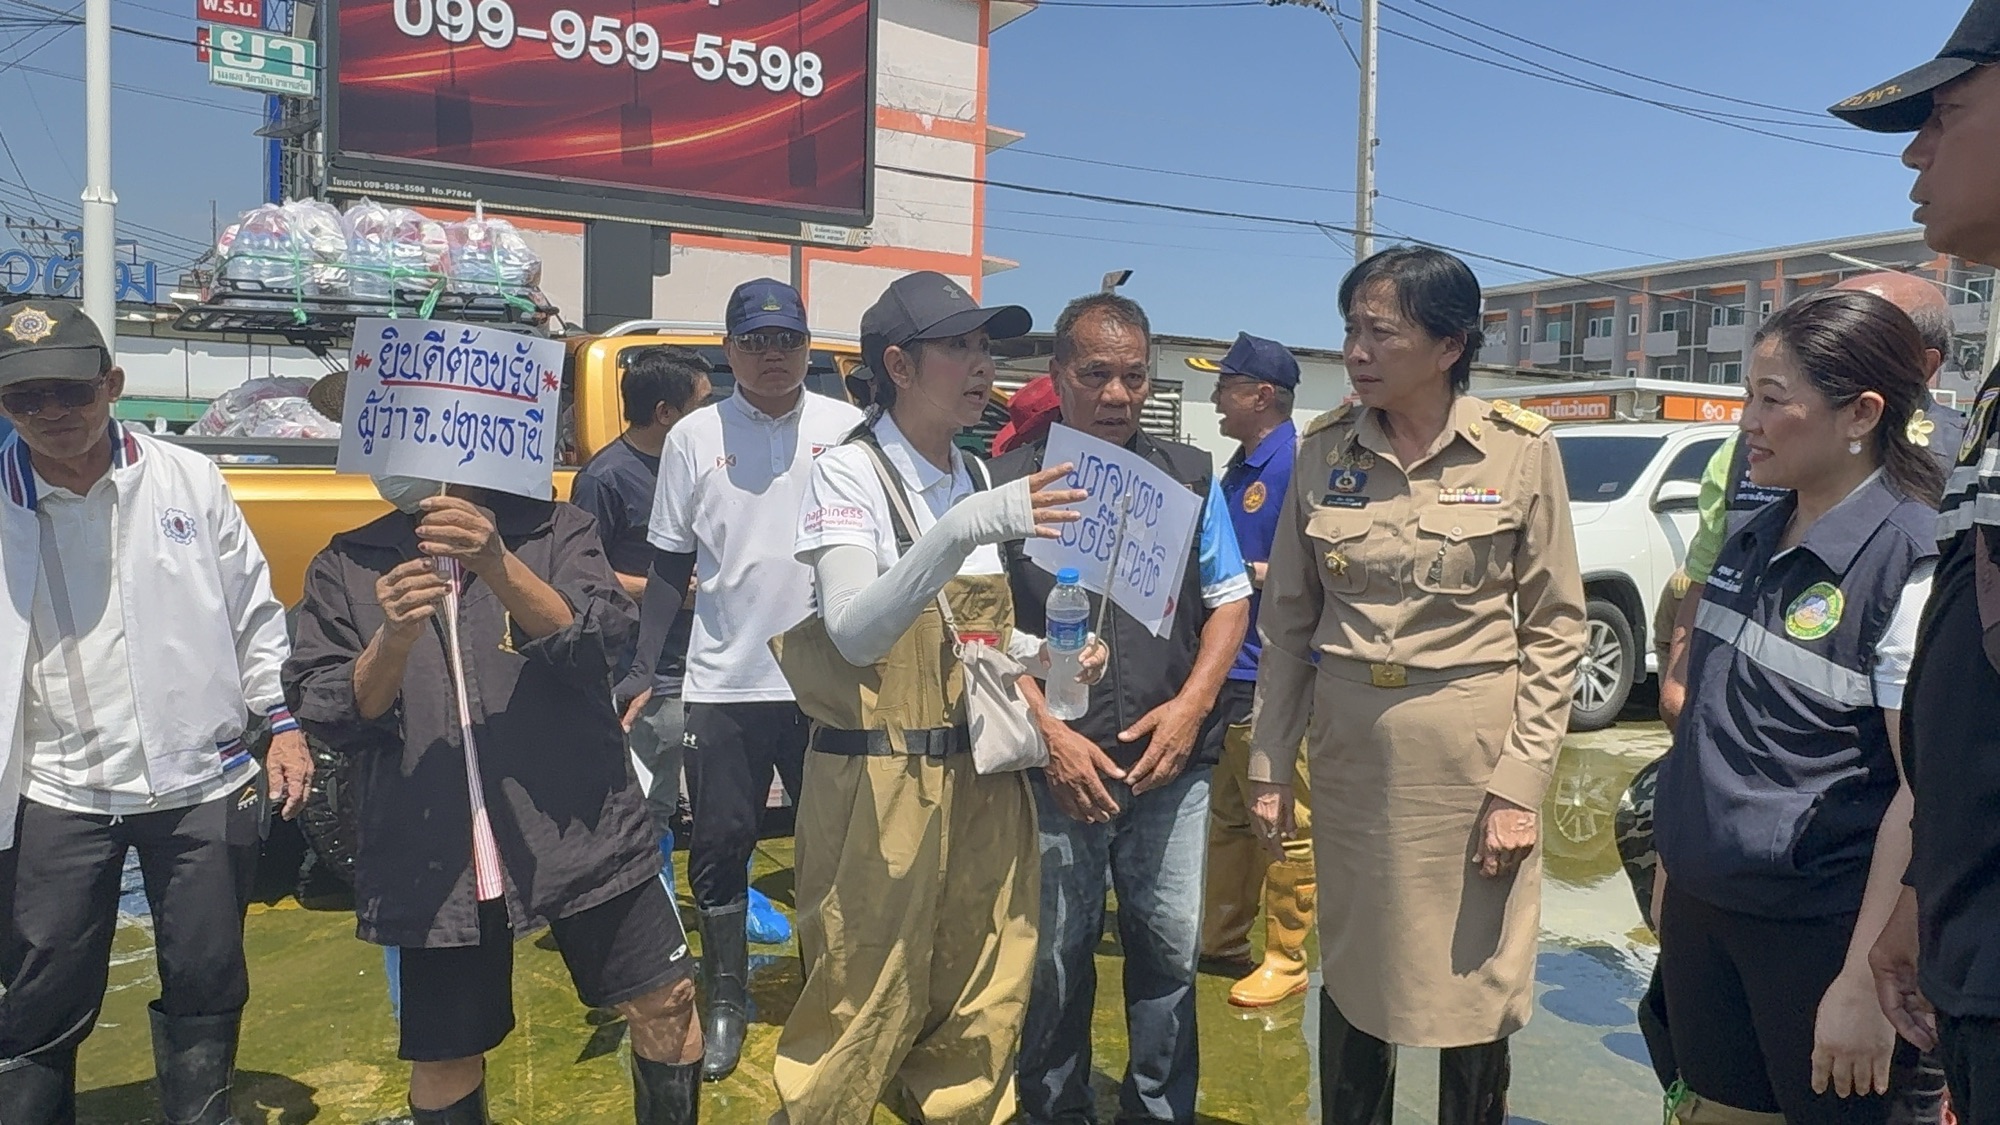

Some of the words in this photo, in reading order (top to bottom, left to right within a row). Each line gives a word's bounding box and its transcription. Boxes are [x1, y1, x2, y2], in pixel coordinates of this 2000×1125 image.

[203, 0, 258, 18] พ.ร.บ.
[220, 30, 306, 78] ยา
[394, 0, 824, 97] 099-959-5598
[804, 506, 864, 524] happiness
